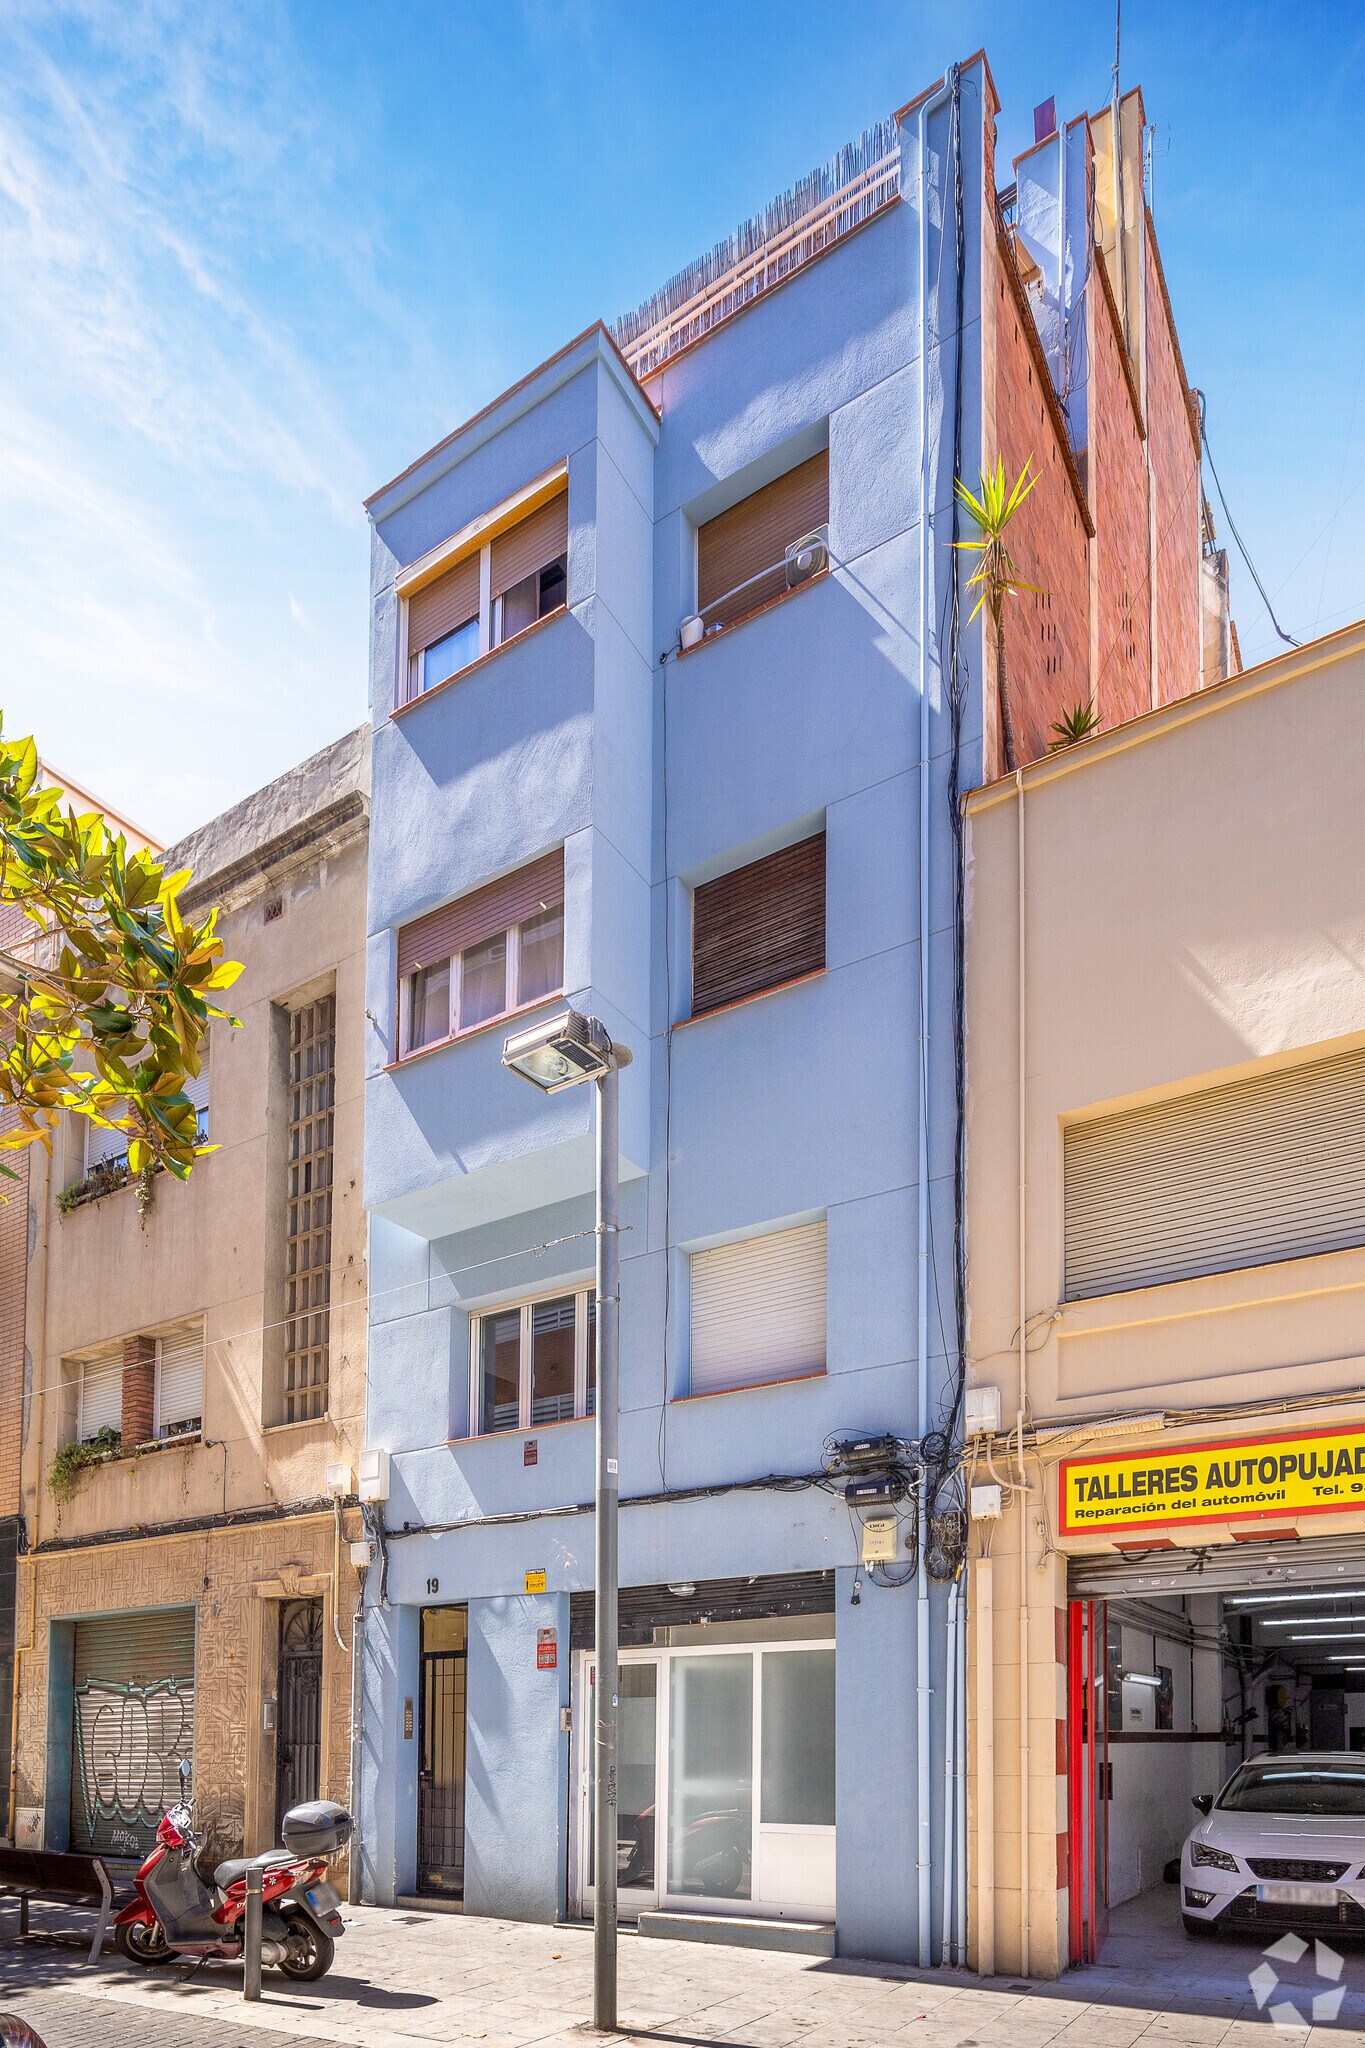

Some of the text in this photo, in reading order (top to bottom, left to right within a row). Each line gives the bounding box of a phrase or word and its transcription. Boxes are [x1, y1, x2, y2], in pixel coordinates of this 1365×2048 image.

[1074, 1465, 1198, 1502] TALLERES
[1074, 1482, 1365, 1519] Reparación del automóvil Tel. 9
[426, 1577, 439, 1594] 19
